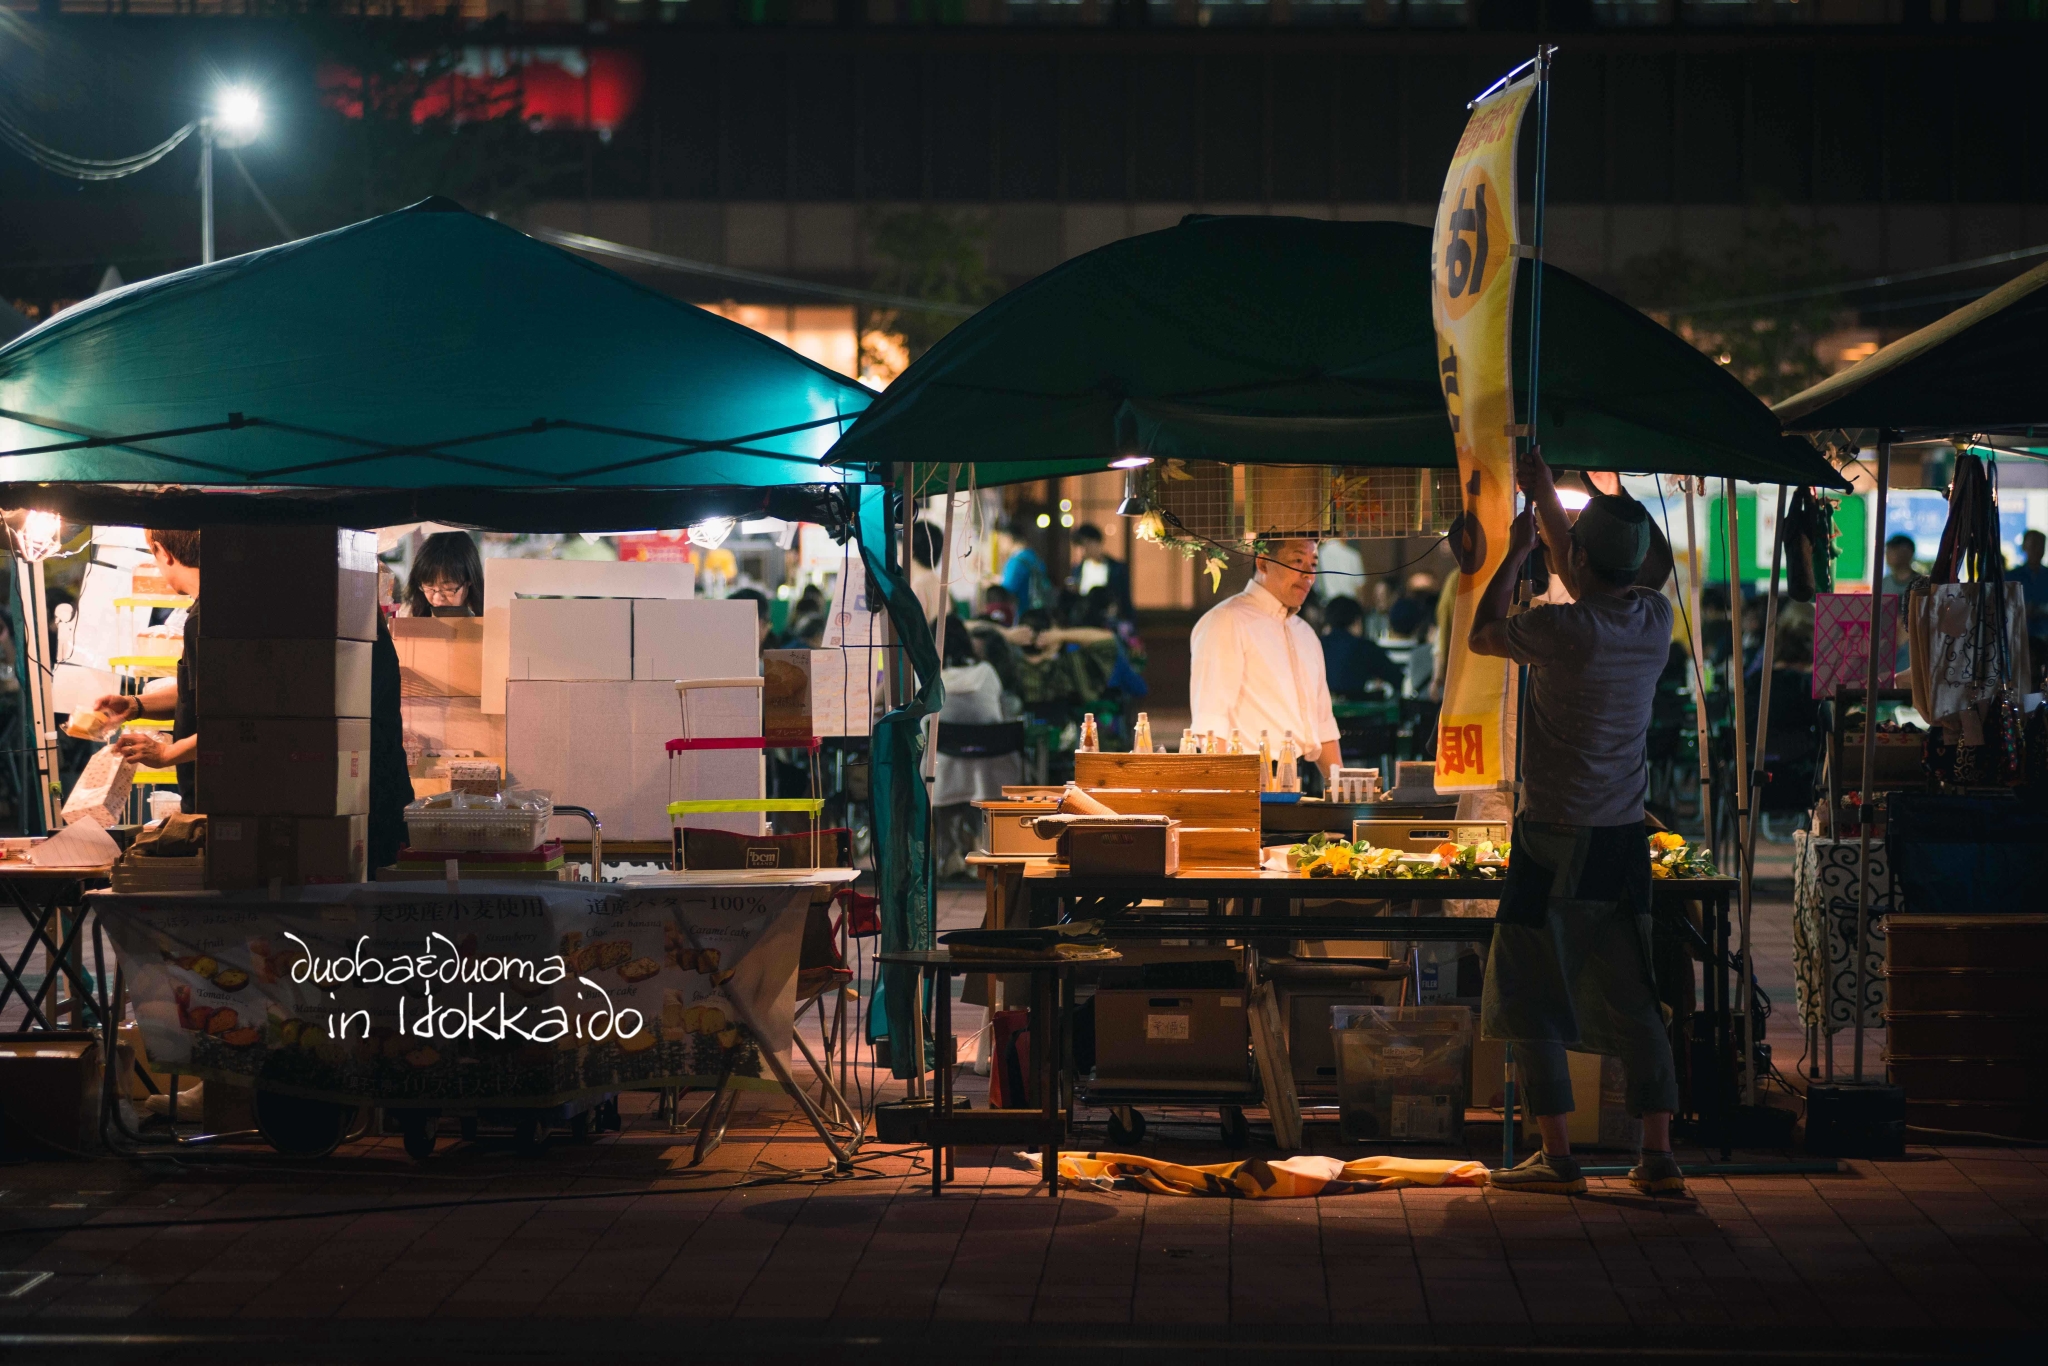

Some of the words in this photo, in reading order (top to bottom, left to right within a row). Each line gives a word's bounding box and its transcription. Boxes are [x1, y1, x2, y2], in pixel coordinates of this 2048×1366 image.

[689, 924, 729, 937] Caramel
[729, 925, 751, 939] cake
[196, 988, 231, 1001] Tomato
[615, 984, 638, 998] cake
